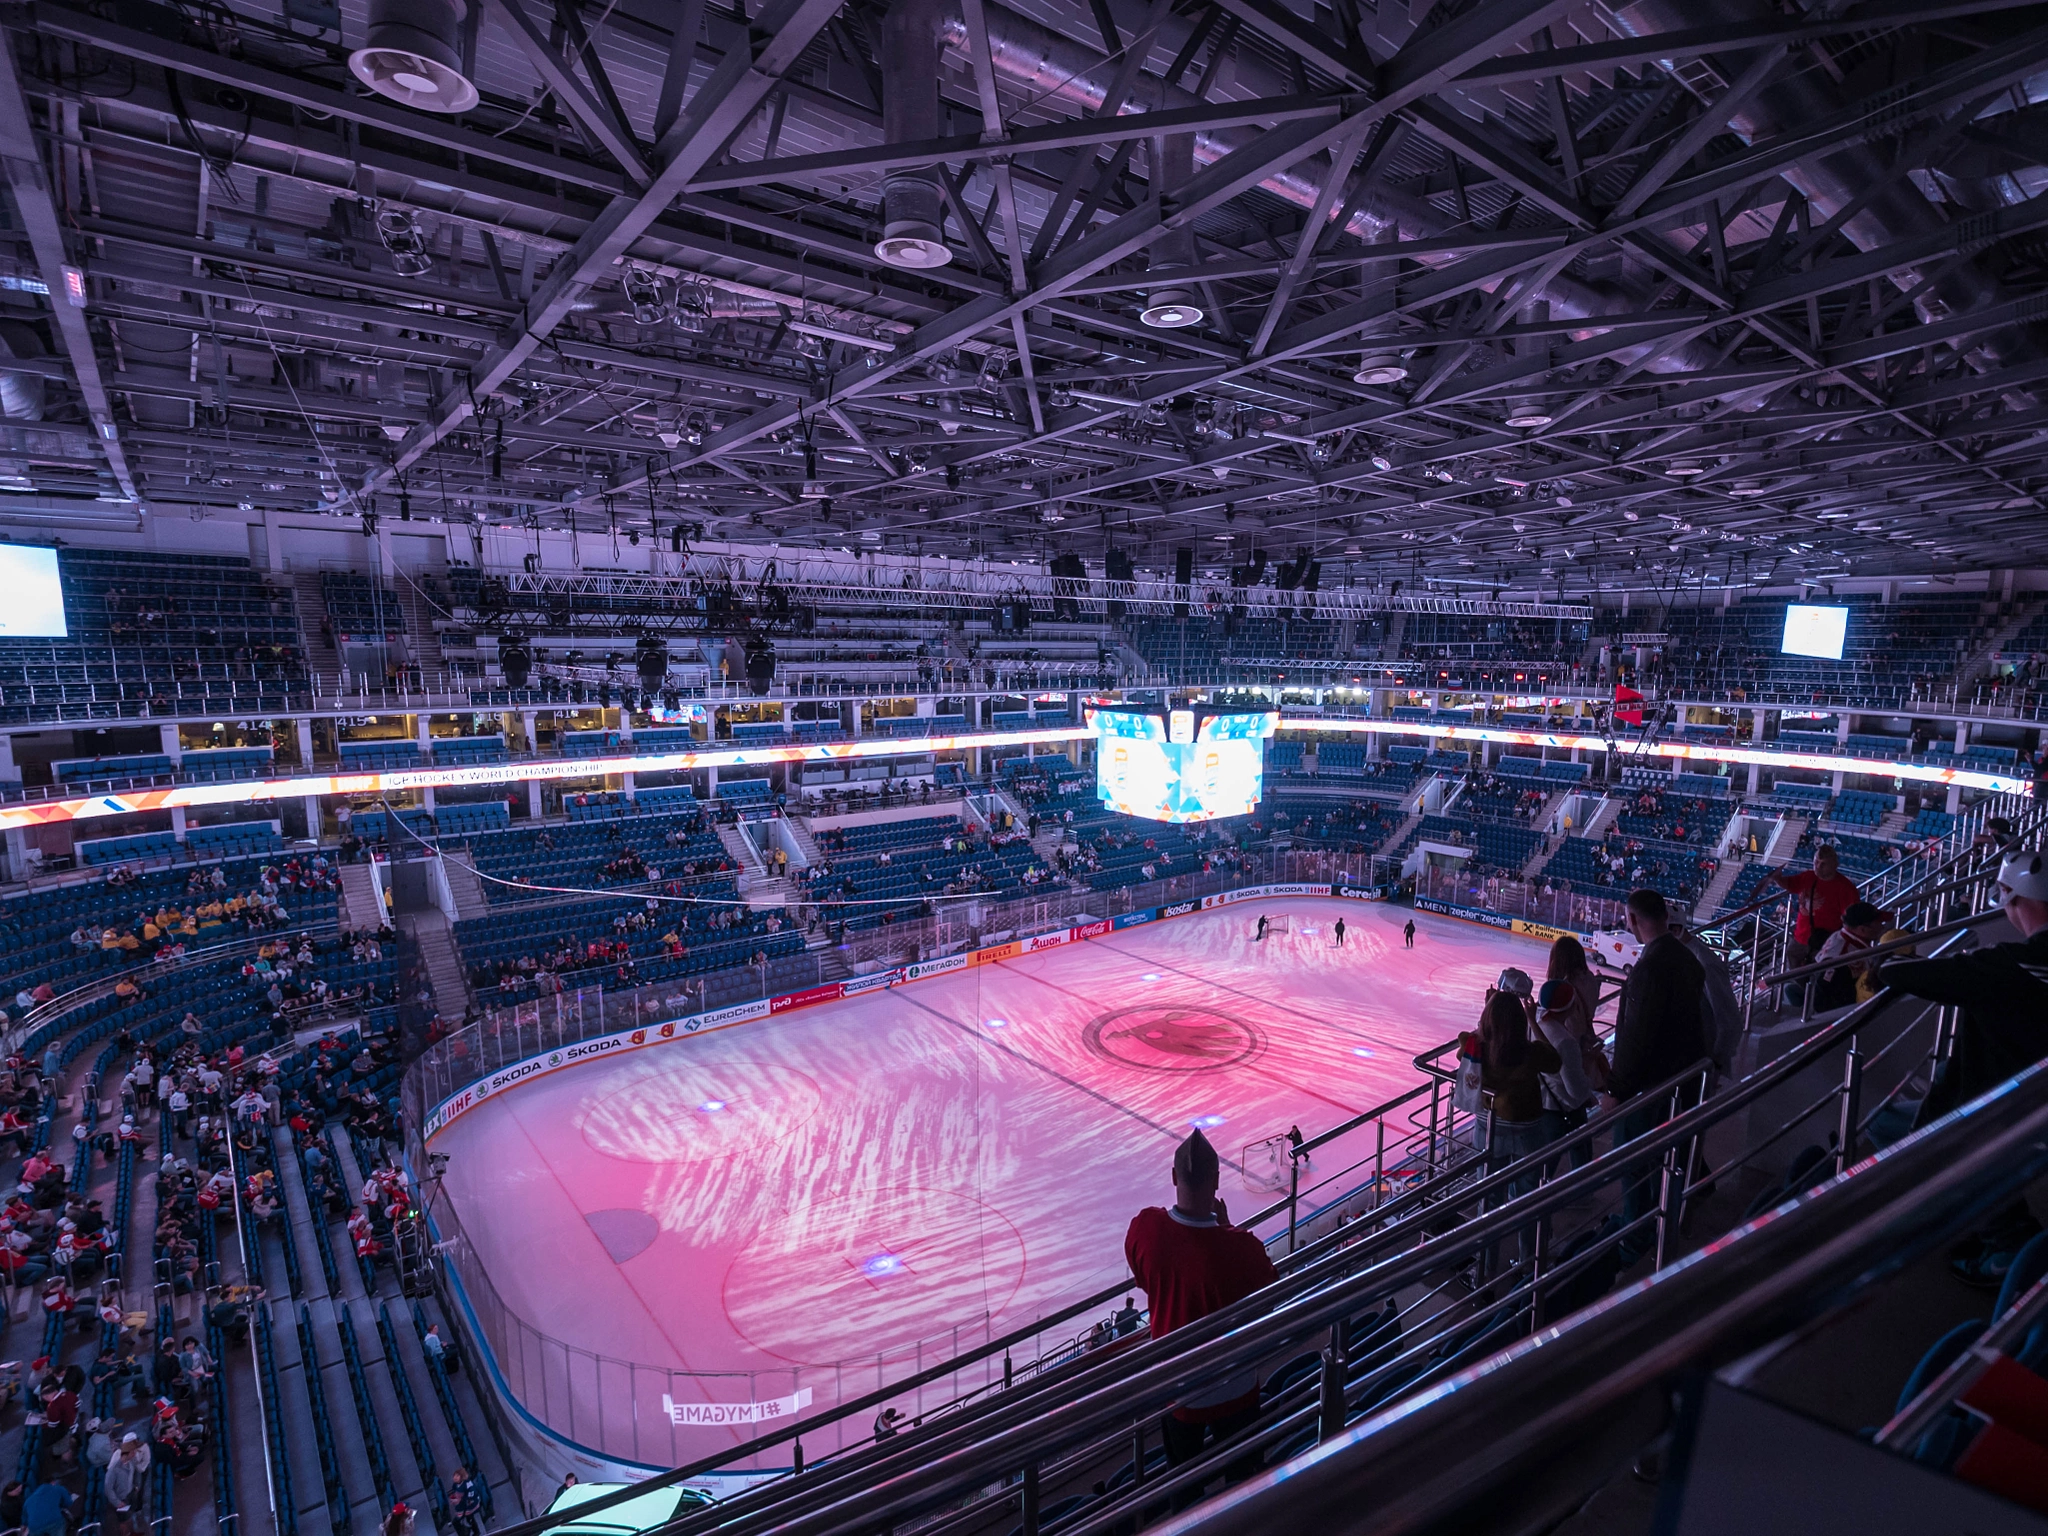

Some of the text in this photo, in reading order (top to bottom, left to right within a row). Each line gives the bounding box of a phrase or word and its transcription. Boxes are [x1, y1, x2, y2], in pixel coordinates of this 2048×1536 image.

[237, 721, 267, 731] 414
[337, 717, 367, 727] 415
[1104, 713, 1113, 728] 0
[1133, 716, 1142, 730] 0
[1221, 718, 1230, 732] 0
[1250, 716, 1259, 729] 0
[413, 773, 466, 784] HOCKEY
[469, 769, 514, 780] WORLD
[517, 763, 603, 776] CHAMPIONSHIP
[1236, 886, 1330, 899] ŠKODA ŠKODA IIHF
[1340, 886, 1382, 900] Ceresit
[1450, 906, 1480, 921] zepter
[1480, 913, 1511, 927] zepter
[1534, 931, 1555, 941] BANK
[1535, 923, 1568, 936] Raiffeisen
[977, 945, 1012, 962] PIRELLI
[447, 1092, 472, 1118] IIHF
[492, 1062, 542, 1088] ŠKODA
[567, 1038, 622, 1060] ŠKODA
